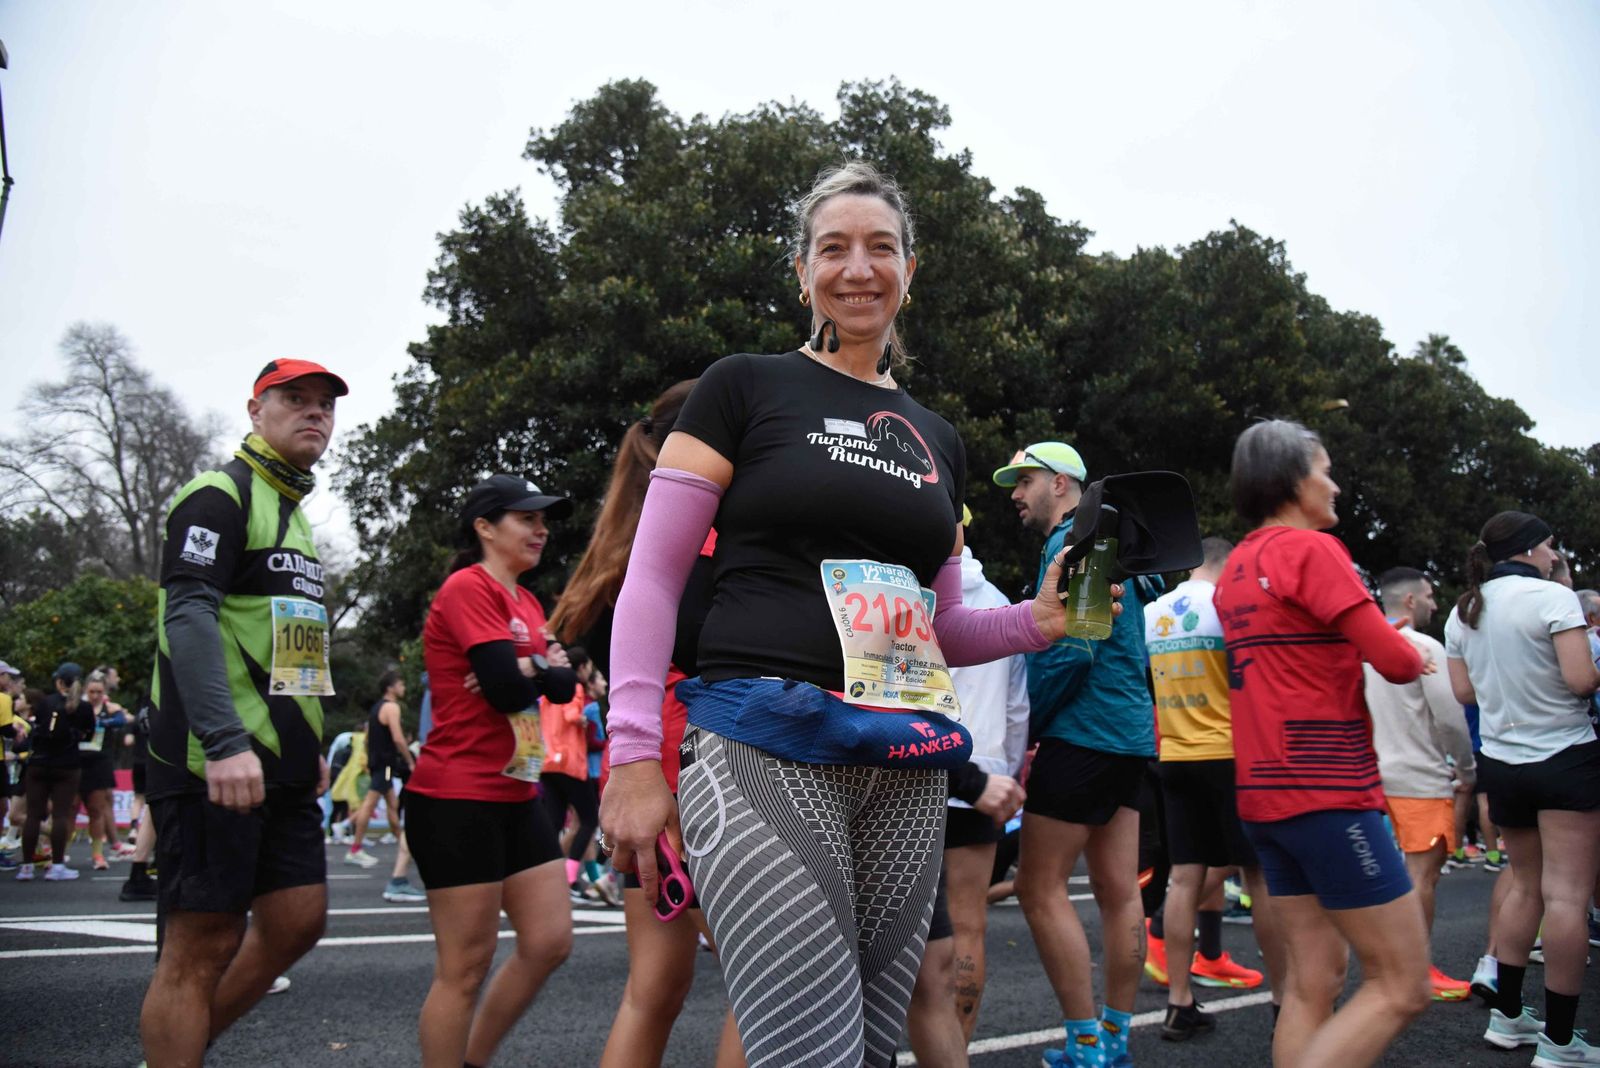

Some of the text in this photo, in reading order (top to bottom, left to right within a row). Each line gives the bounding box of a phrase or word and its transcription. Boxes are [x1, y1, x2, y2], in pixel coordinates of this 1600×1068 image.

[807, 433, 877, 452] Turismo
[828, 446, 921, 489] Running
[845, 592, 938, 645] 2103
[895, 656, 928, 668] Schez
[905, 676, 927, 684] Edición
[887, 732, 964, 759] HANKER
